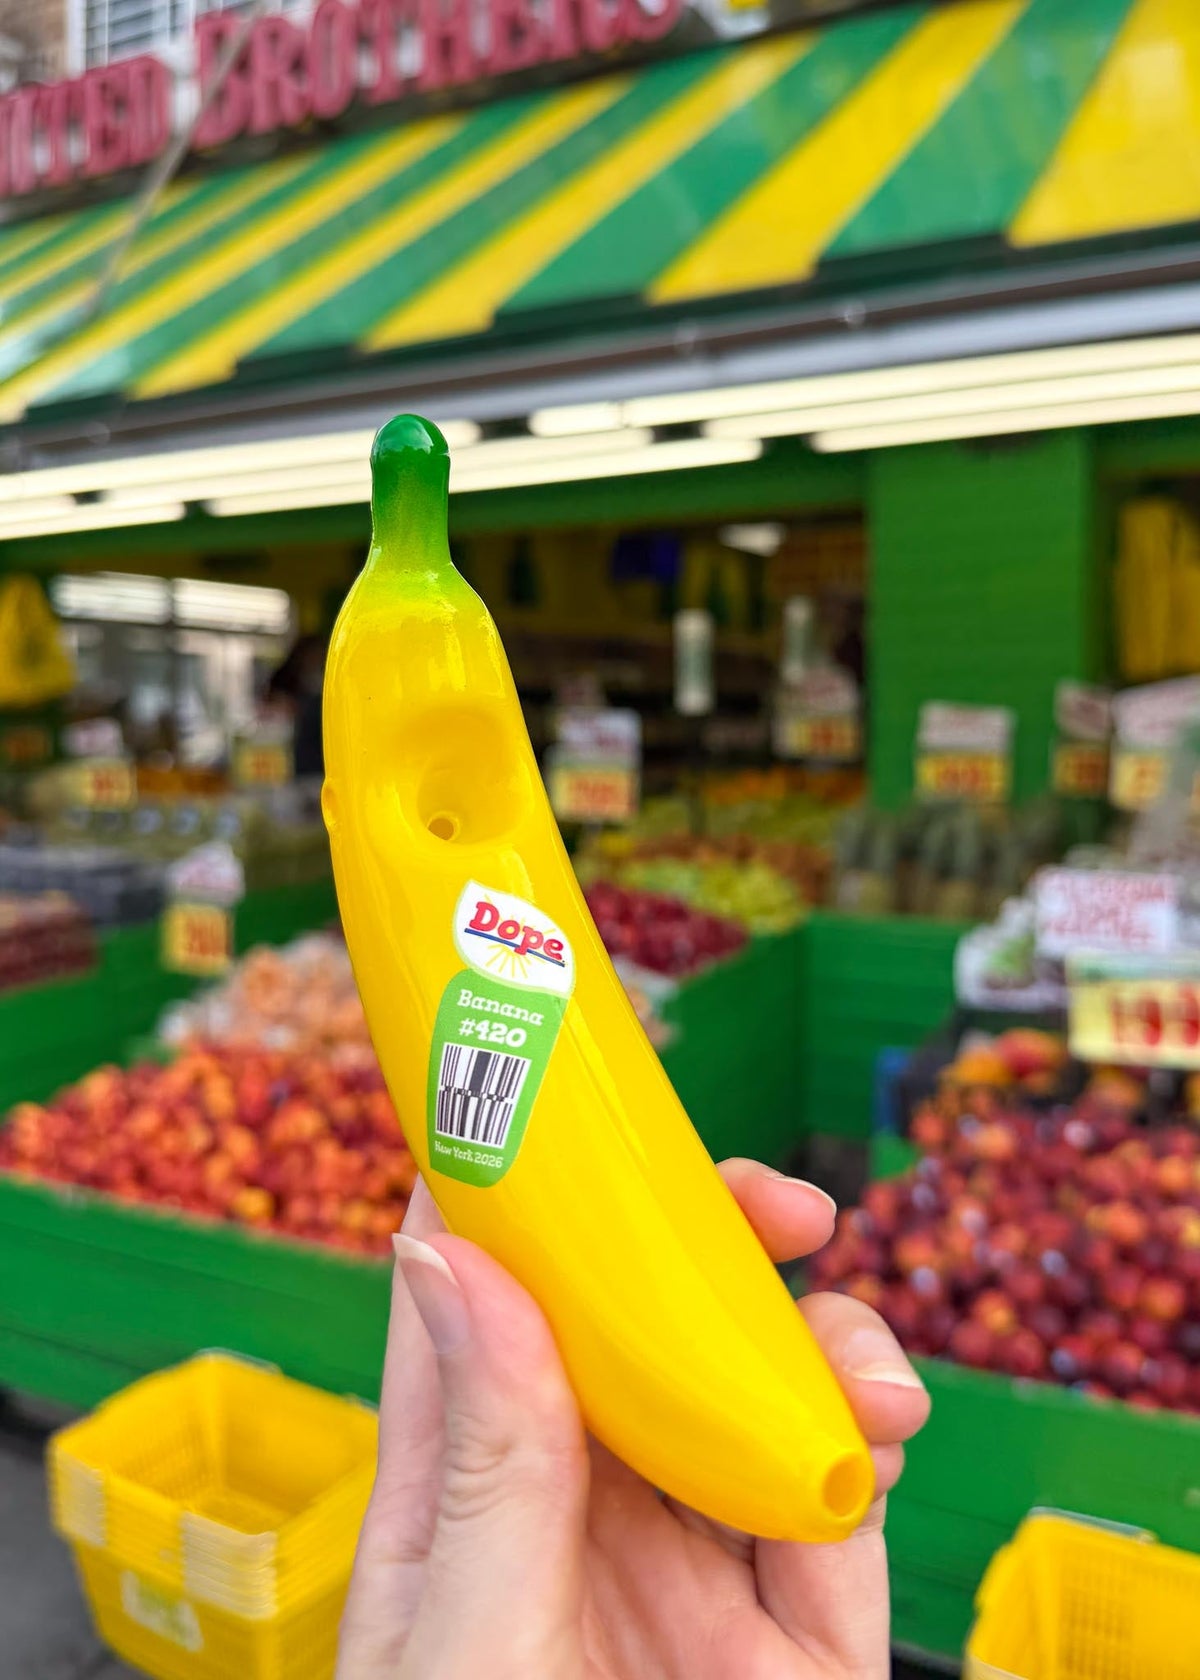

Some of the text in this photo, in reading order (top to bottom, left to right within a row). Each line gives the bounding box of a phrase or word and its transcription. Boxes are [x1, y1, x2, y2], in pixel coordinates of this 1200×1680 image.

[469, 901, 564, 961] Dope
[457, 989, 545, 1026] Banana
[459, 1018, 527, 1048] #420
[435, 1140, 504, 1168] New York 2026
